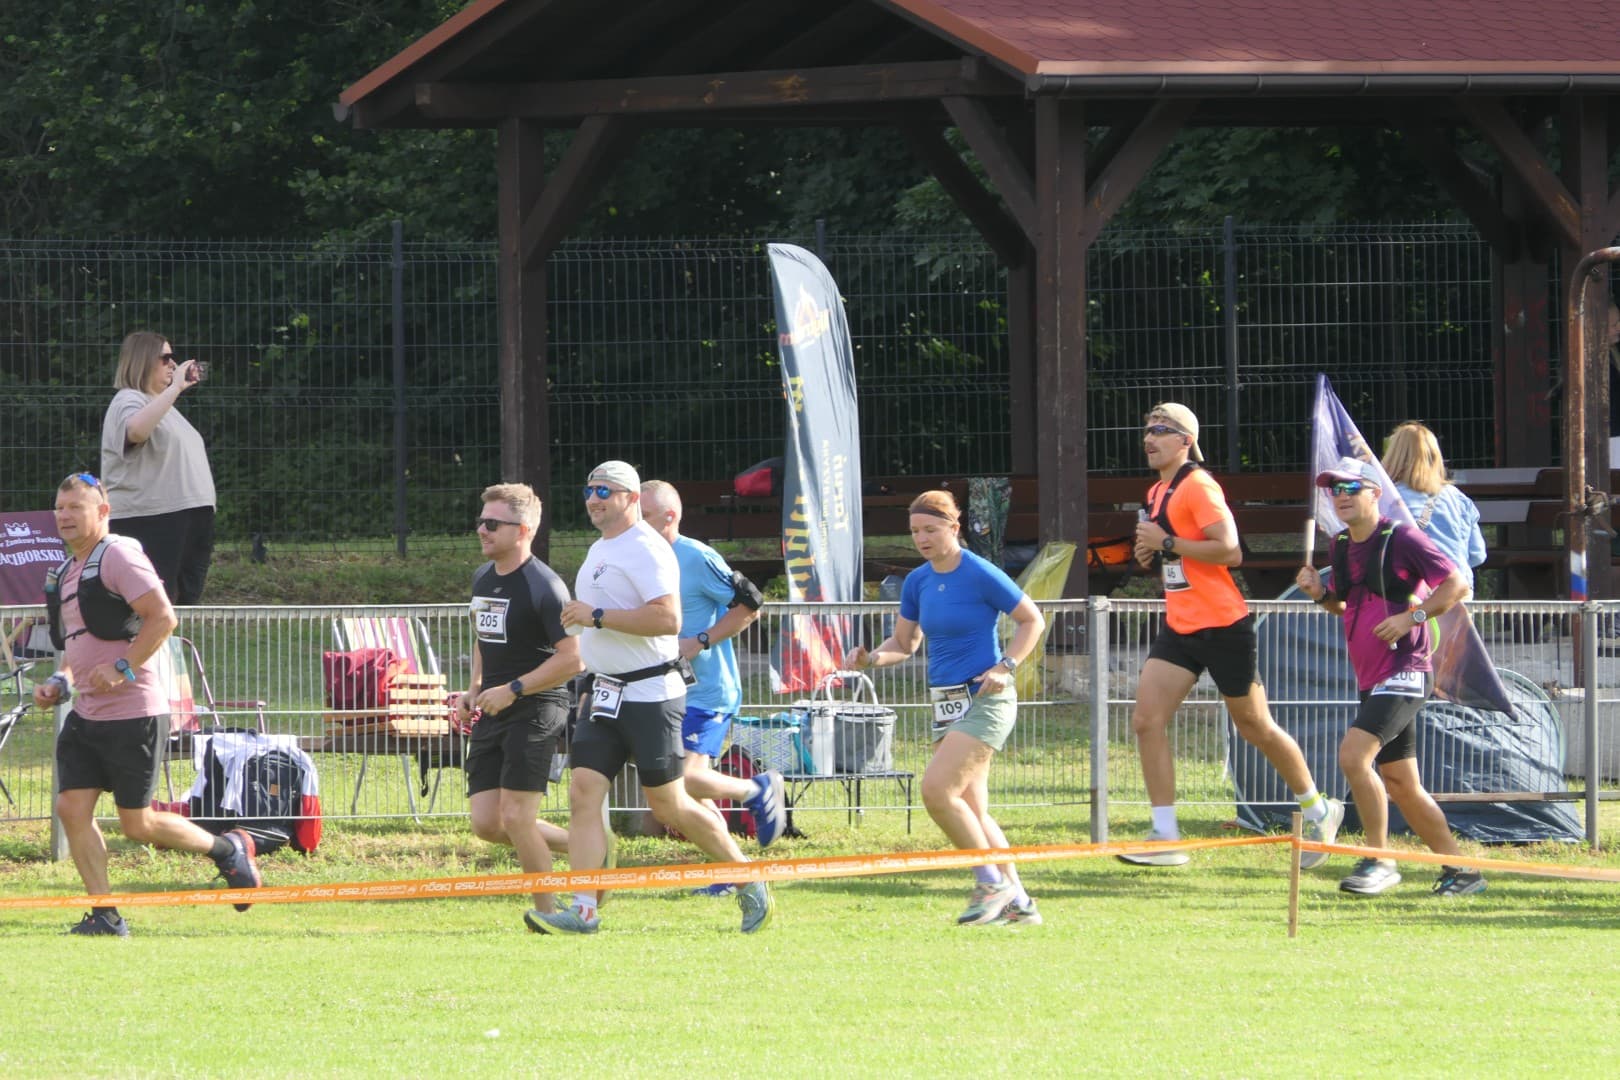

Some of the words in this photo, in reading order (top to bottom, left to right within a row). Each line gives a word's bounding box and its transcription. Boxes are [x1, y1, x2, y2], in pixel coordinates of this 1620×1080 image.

[480, 614, 498, 627] 205
[939, 701, 962, 715] 109
[454, 880, 485, 891] trasa
